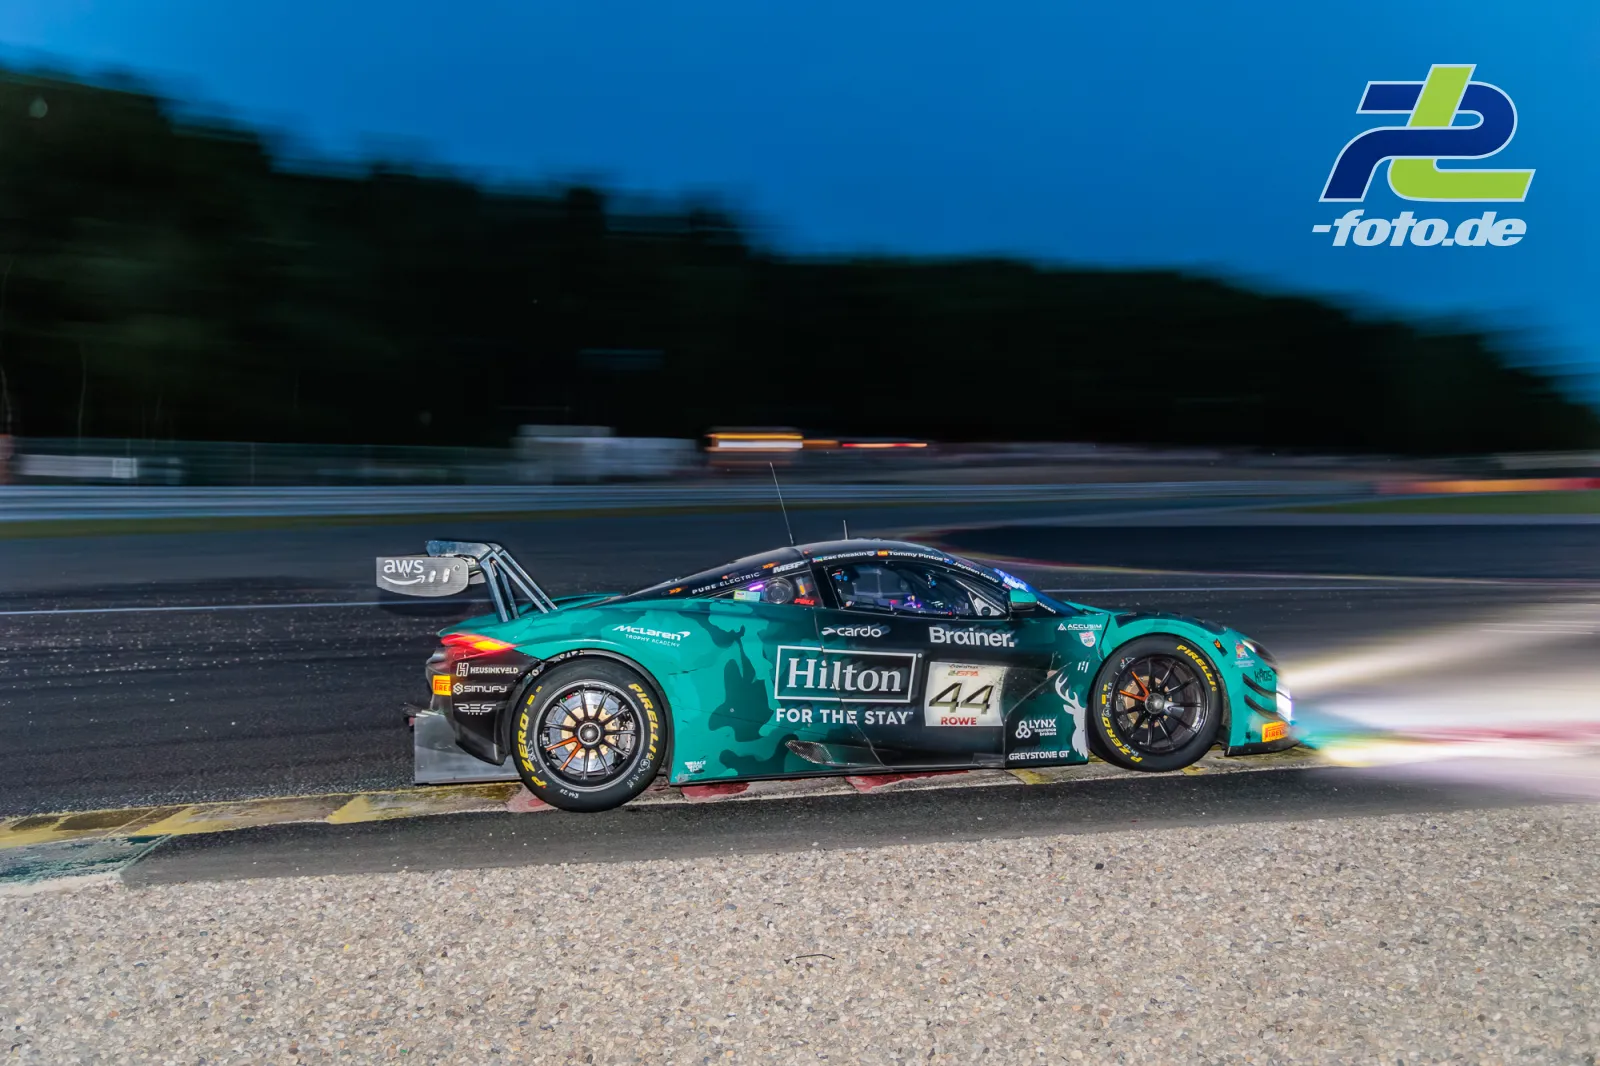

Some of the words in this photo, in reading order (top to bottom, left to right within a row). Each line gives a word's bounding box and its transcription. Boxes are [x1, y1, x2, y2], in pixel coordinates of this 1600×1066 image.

[889, 550, 917, 558] Tommy
[918, 553, 943, 562] Pintos
[384, 560, 424, 574] aws
[692, 584, 717, 595] PURE
[719, 572, 761, 587] ELECTRIC
[612, 625, 685, 641] McLaren
[625, 633, 650, 642] TROPHY
[652, 638, 681, 647] ACADEMY
[836, 626, 882, 638] cardo
[470, 666, 519, 674] HEUSINKVELD
[1176, 644, 1217, 686] PIRELLI
[786, 657, 901, 692] Hilton
[928, 682, 995, 715] 44
[628, 683, 659, 754] PIRELLI
[776, 708, 812, 723] FOR
[820, 709, 857, 724] THE
[940, 716, 977, 726] ROWE
[1029, 719, 1057, 729] LYNX
[517, 712, 535, 772] ZERO
[1102, 715, 1131, 756] ZERO
[1008, 751, 1058, 760] GREYSTONE
[1059, 750, 1070, 758] GT
